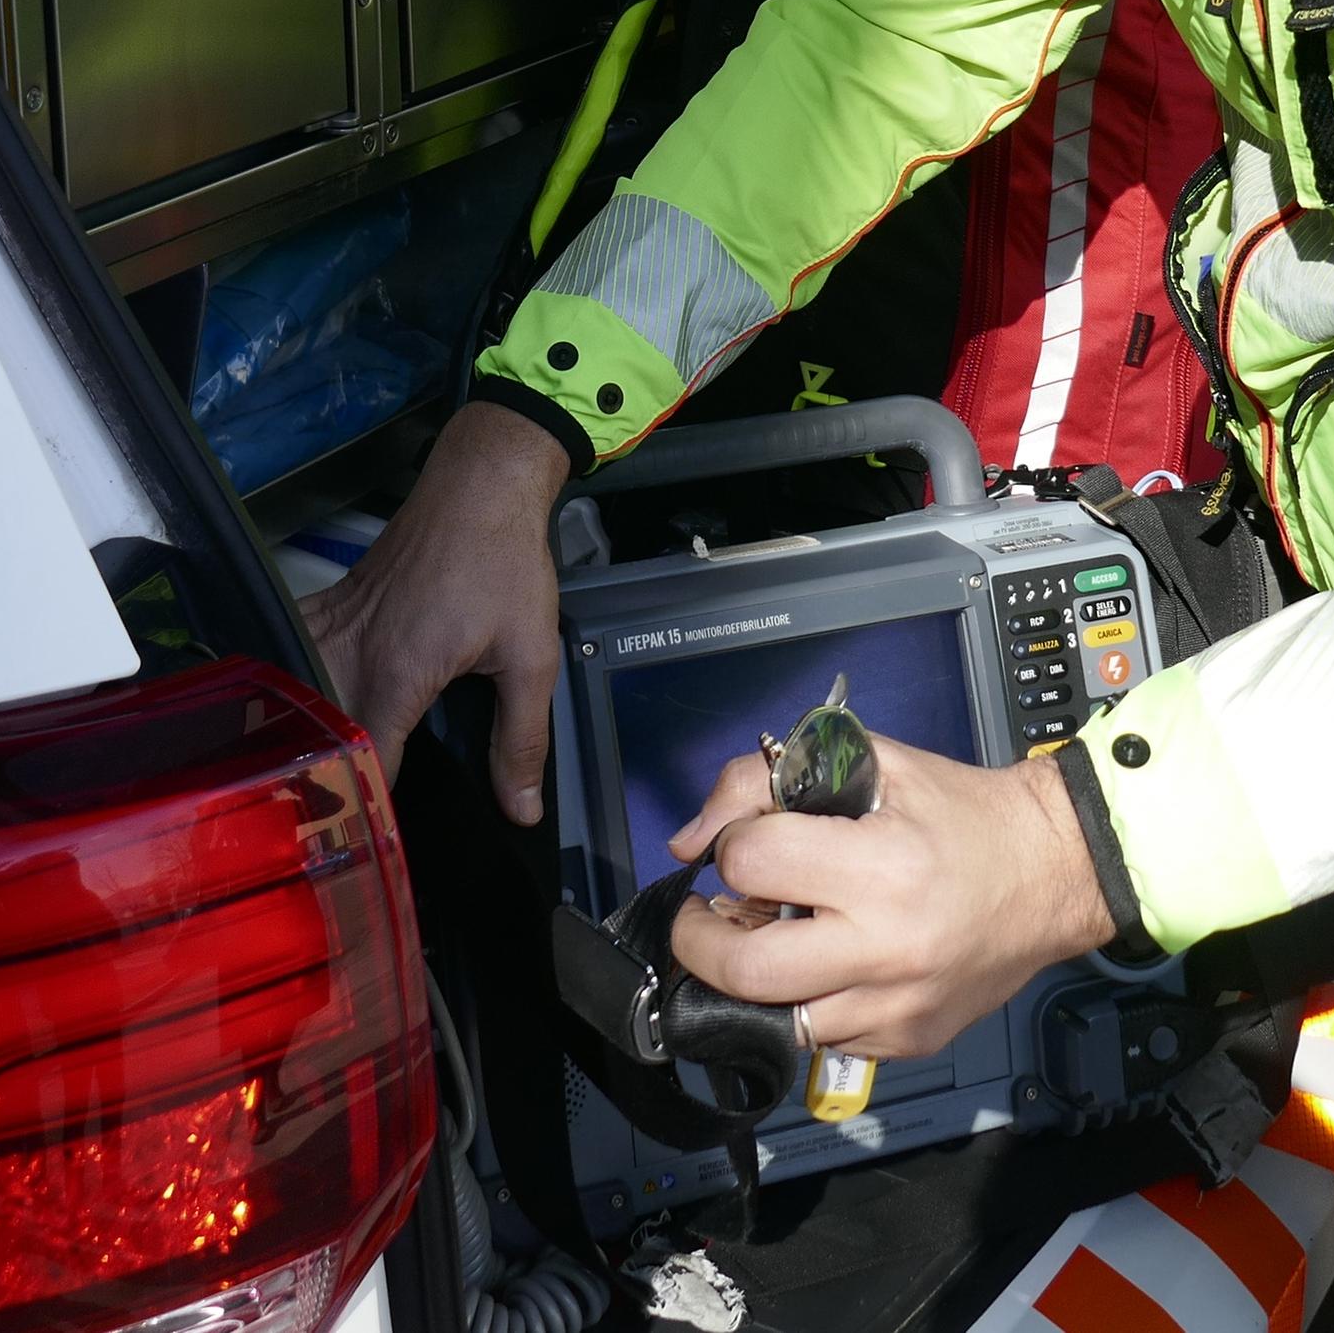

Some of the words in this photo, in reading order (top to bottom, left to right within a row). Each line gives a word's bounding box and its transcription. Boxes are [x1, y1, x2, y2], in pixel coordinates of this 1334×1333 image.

[1091, 572, 1119, 585] ACCESO
[1058, 578, 1067, 593] 1
[1096, 600, 1115, 610] SELEZ
[1030, 616, 1045, 627] RCP
[1063, 608, 1073, 624] 2
[617, 630, 666, 654] LIFEPAK
[668, 628, 681, 644] 15
[685, 613, 791, 642] MONITOR/DEFIBRILLATORE
[1097, 628, 1122, 639] CARICA
[1028, 639, 1059, 652] ANALIZZA
[1067, 632, 1077, 648] 3
[1020, 669, 1037, 680] DER.
[1041, 691, 1058, 702] SINC
[1046, 722, 1063, 733] PSNI
